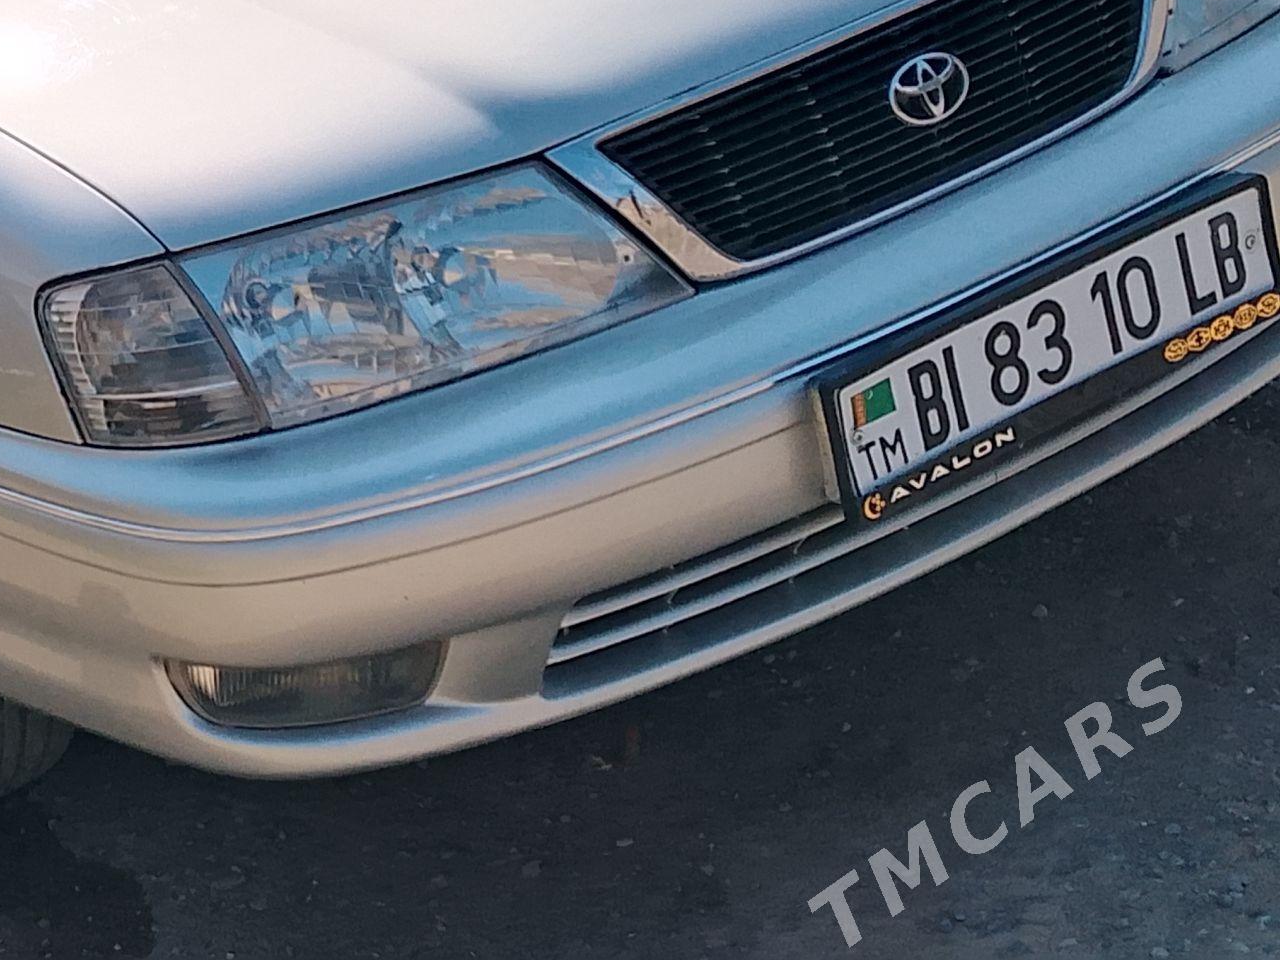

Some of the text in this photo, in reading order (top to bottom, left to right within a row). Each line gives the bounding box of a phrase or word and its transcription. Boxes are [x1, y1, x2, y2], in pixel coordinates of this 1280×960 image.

[908, 211, 1247, 452] BI 83 10 LB
[858, 427, 910, 481] TM
[890, 426, 1016, 504] AVALON
